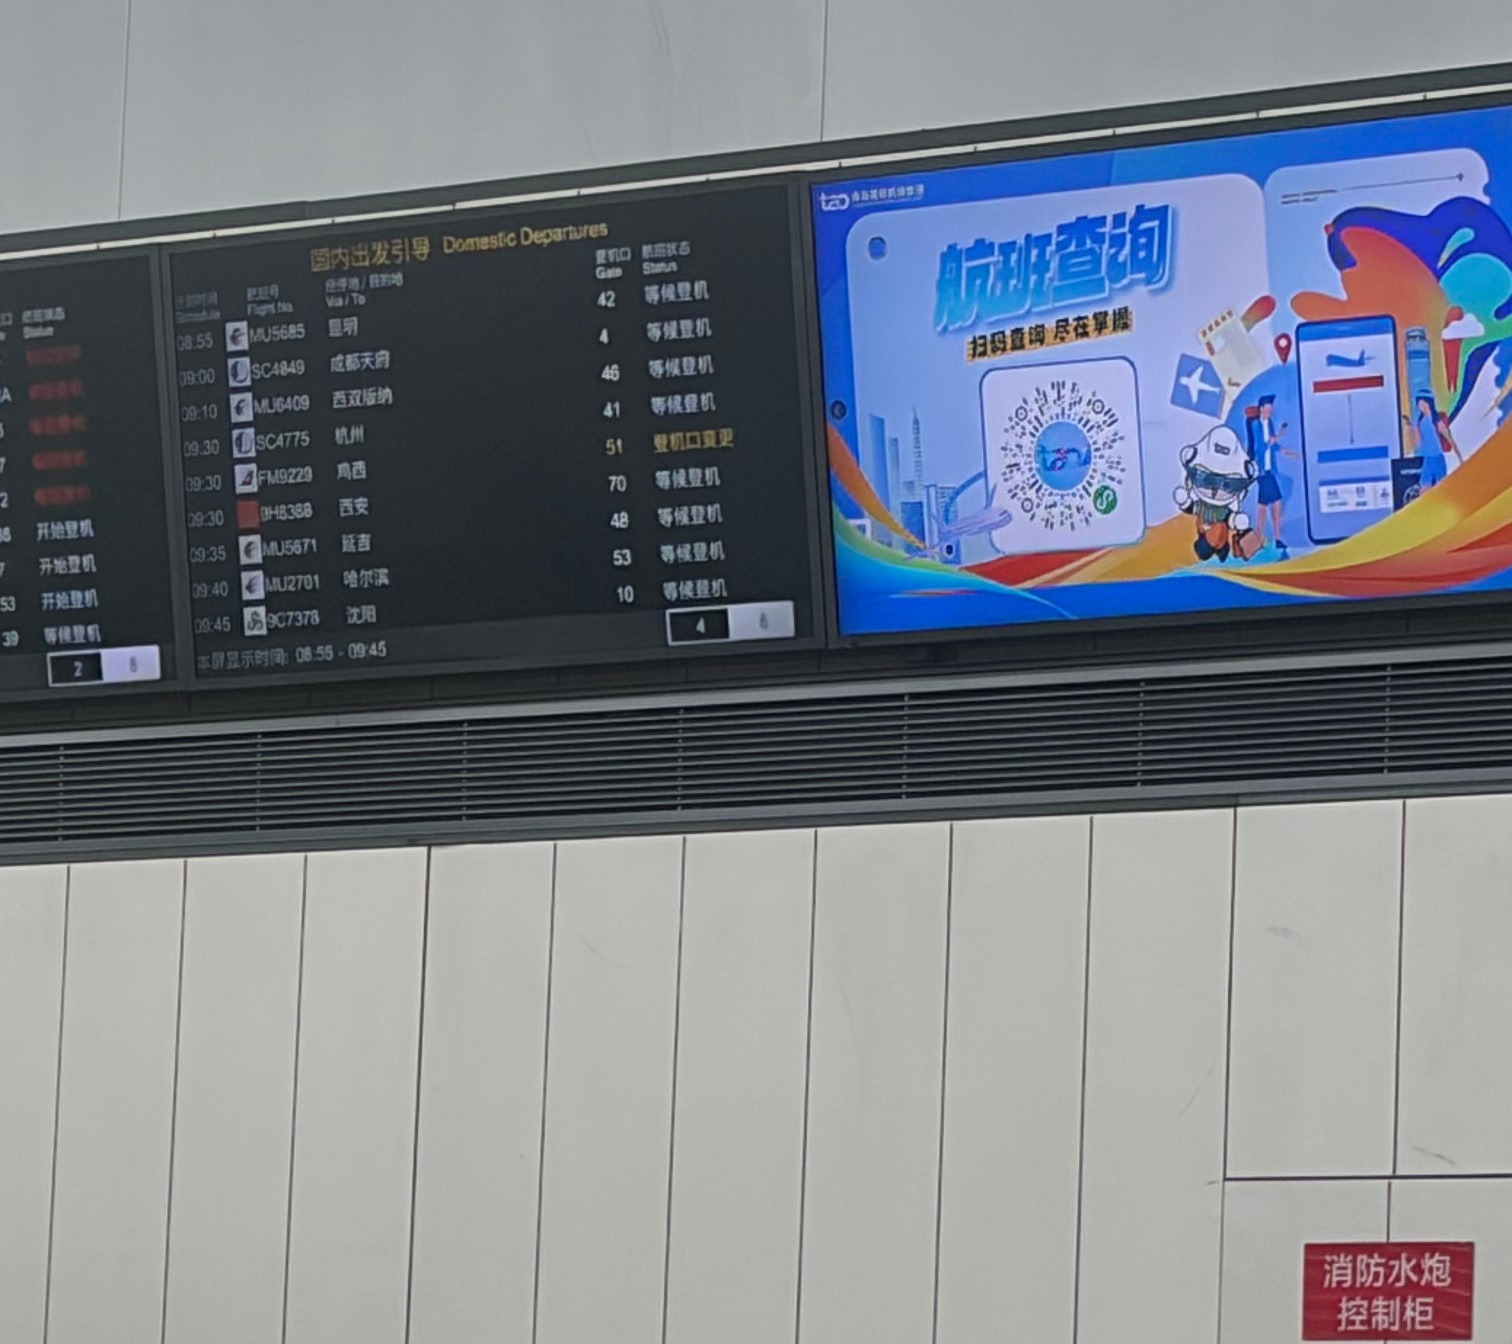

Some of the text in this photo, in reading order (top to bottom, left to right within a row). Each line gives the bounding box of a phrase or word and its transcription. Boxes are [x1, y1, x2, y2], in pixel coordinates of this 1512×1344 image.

[310, 223, 608, 272] 国内出发引导 Domestic Departures
[933, 204, 1175, 332] 航班查询
[597, 291, 616, 308] 42
[599, 329, 609, 345] 4
[969, 307, 1131, 360] 扫码查询 尽在掌握
[180, 369, 215, 386] 09:00
[252, 359, 305, 379] SC4849
[181, 404, 217, 422] 09:10
[254, 395, 309, 415] MU6409
[603, 401, 621, 419] 41
[184, 439, 220, 457] 09:30
[257, 432, 310, 451] SC4775
[606, 439, 623, 455] 51
[608, 475, 627, 493] 70
[190, 546, 226, 563] 09:35
[612, 549, 632, 566] 53
[192, 581, 228, 598] 09:40
[266, 574, 320, 593] MU2701
[617, 586, 634, 604] 10
[296, 645, 334, 662] 08:55
[348, 641, 387, 659] 09:45
[1323, 1252, 1452, 1288] 消防水炮
[1337, 1295, 1434, 1332] 控制柜
